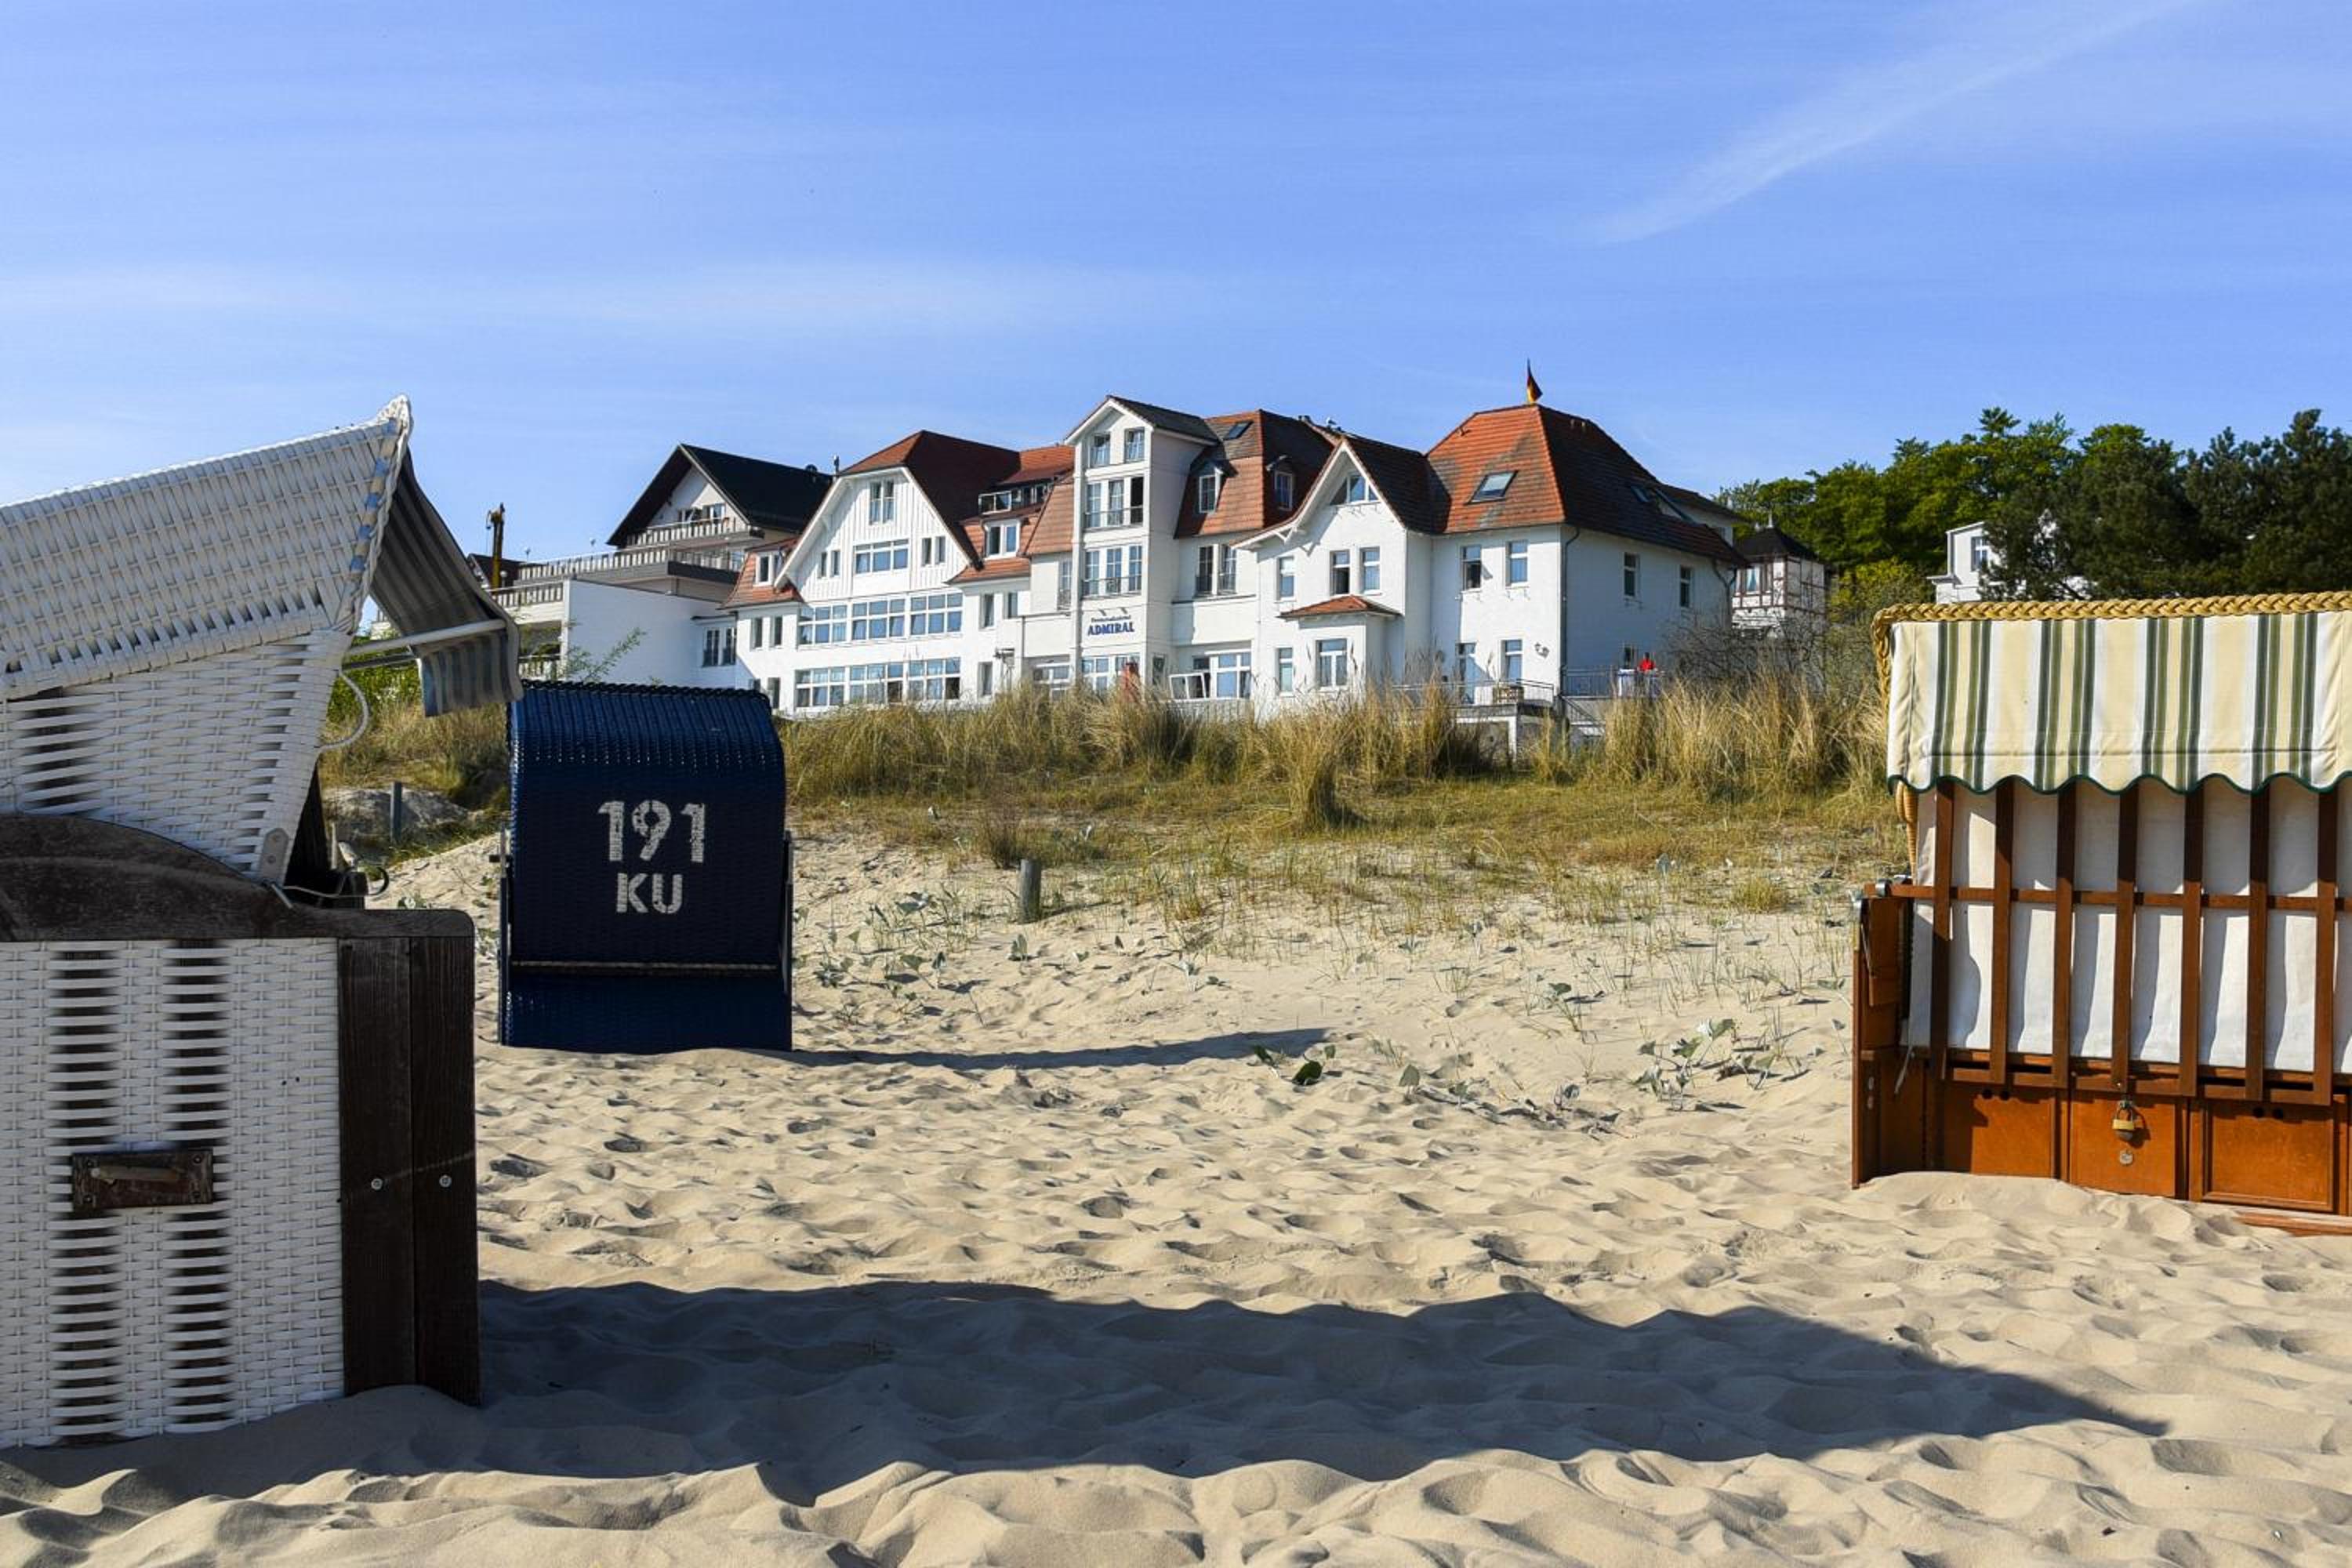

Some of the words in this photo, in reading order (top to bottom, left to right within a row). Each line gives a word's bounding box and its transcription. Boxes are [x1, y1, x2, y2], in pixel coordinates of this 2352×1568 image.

[1087, 622, 1135, 636] ADMIRAL
[597, 800, 706, 863] 191
[616, 873, 683, 914] KU
